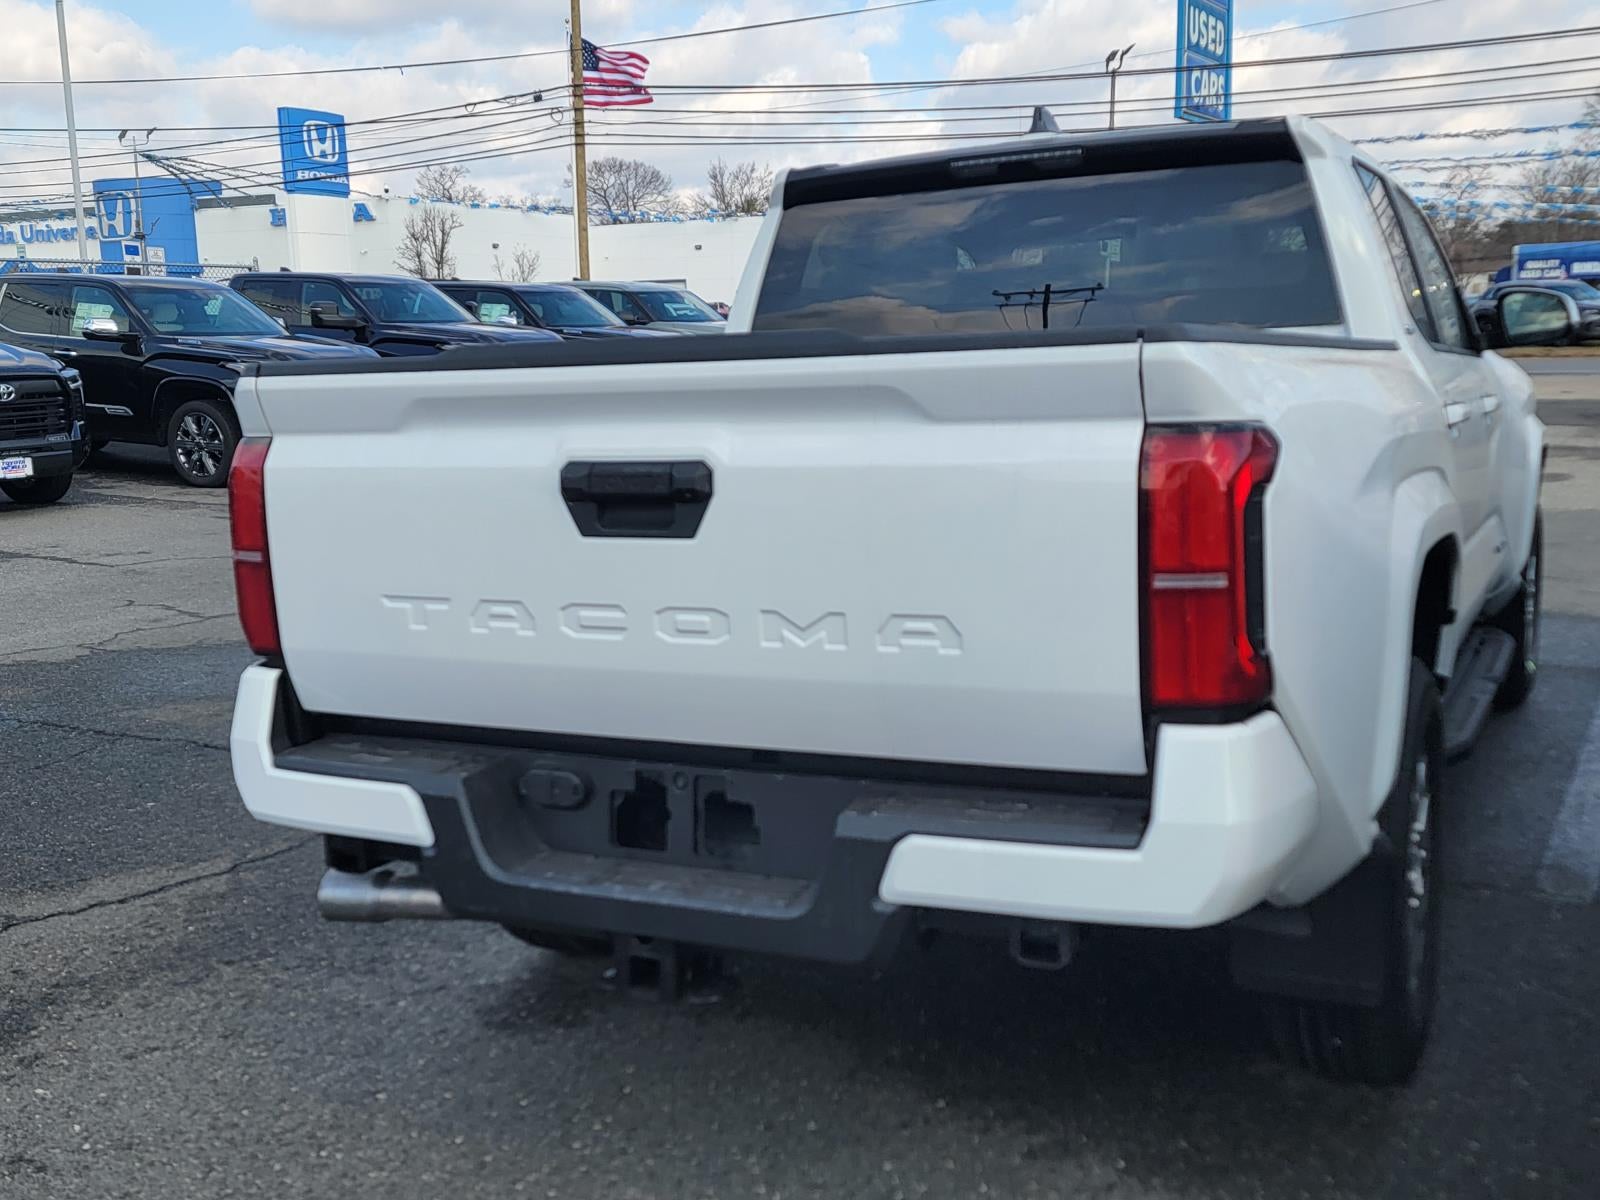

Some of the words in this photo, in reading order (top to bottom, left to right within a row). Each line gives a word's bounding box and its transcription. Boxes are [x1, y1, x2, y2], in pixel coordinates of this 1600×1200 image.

[1189, 5, 1225, 57] USED
[1191, 69, 1225, 112] CARS
[296, 169, 349, 184] HONDA
[20, 223, 97, 242] Univere
[380, 594, 964, 655] TACOMA
